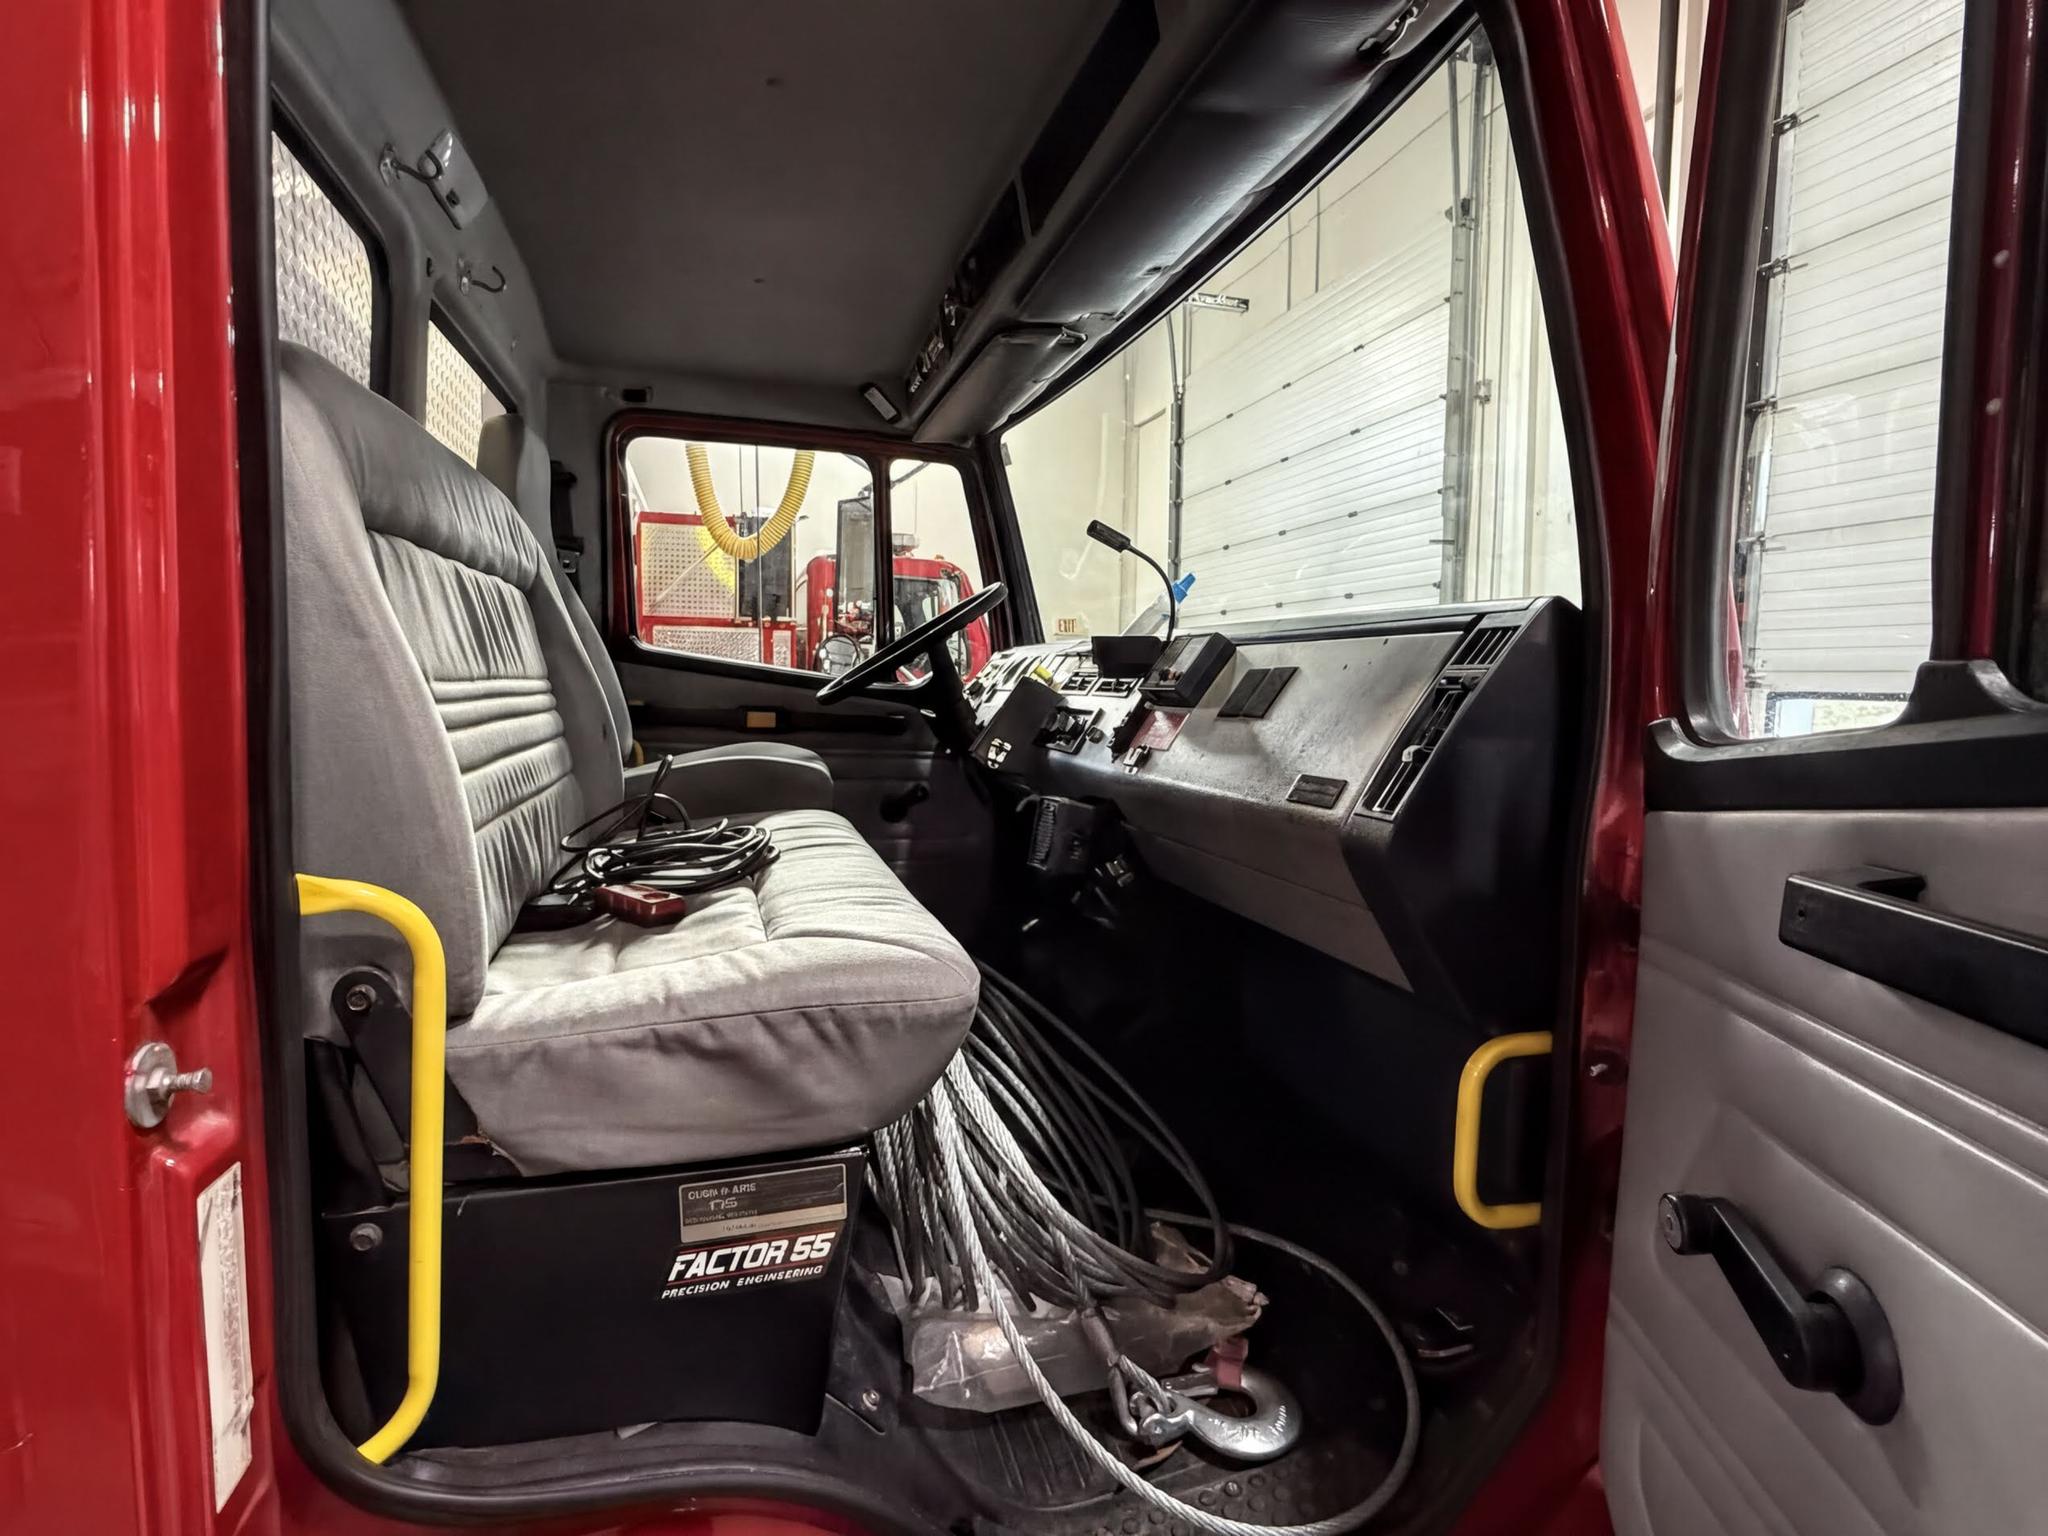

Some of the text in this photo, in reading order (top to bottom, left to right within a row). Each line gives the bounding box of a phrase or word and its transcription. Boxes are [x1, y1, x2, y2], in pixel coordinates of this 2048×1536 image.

[1058, 618, 1077, 633] EXIT
[667, 1232, 836, 1282] FACTOR 55
[661, 1280, 730, 1299] PRECISION
